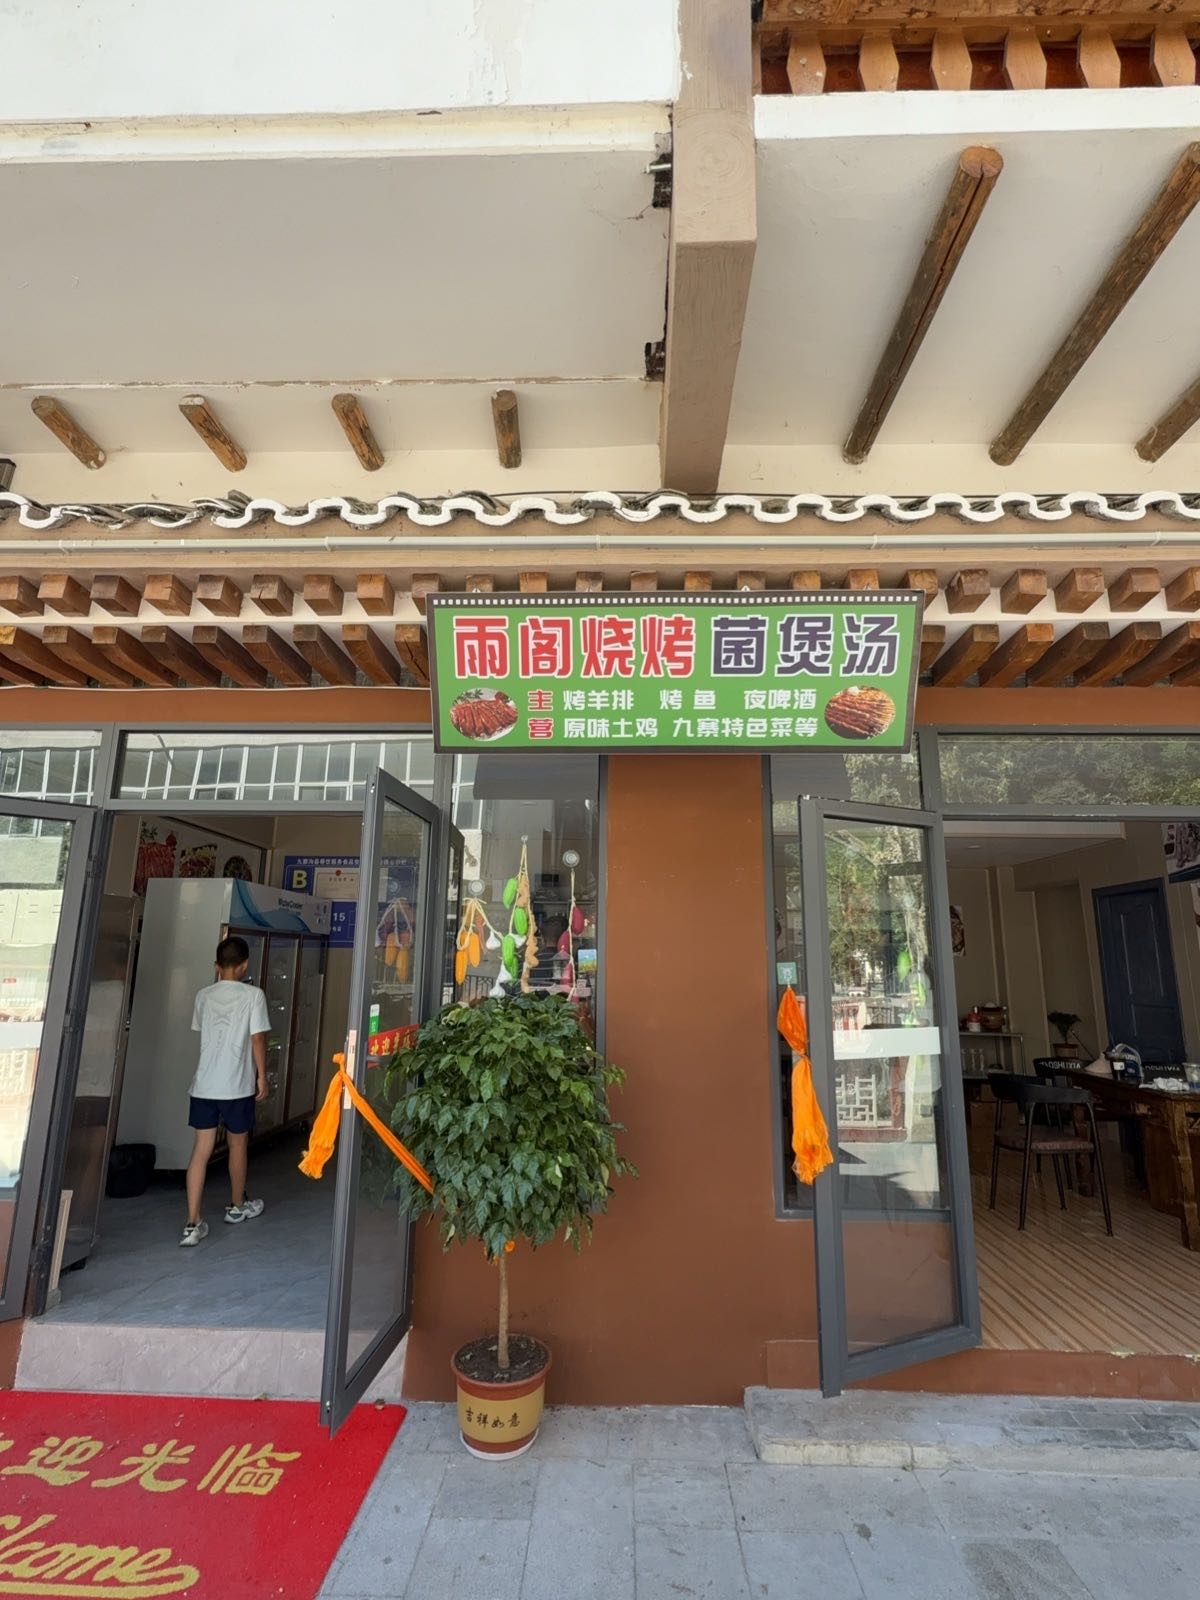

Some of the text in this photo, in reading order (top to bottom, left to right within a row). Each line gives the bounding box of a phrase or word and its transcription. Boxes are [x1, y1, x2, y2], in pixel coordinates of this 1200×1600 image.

[453, 613, 899, 678] 雨阁烧烤 菌煲汤
[563, 690, 634, 711] 烤羊排
[744, 689, 816, 710] 夜啤酒
[528, 690, 554, 740] 主营
[563, 717, 818, 739] 原味土鸡 九寨特色菜等
[292, 870, 308, 890] B
[465, 1407, 521, 1429] 吉祥如意
[0, 1433, 301, 1495] 迎光临
